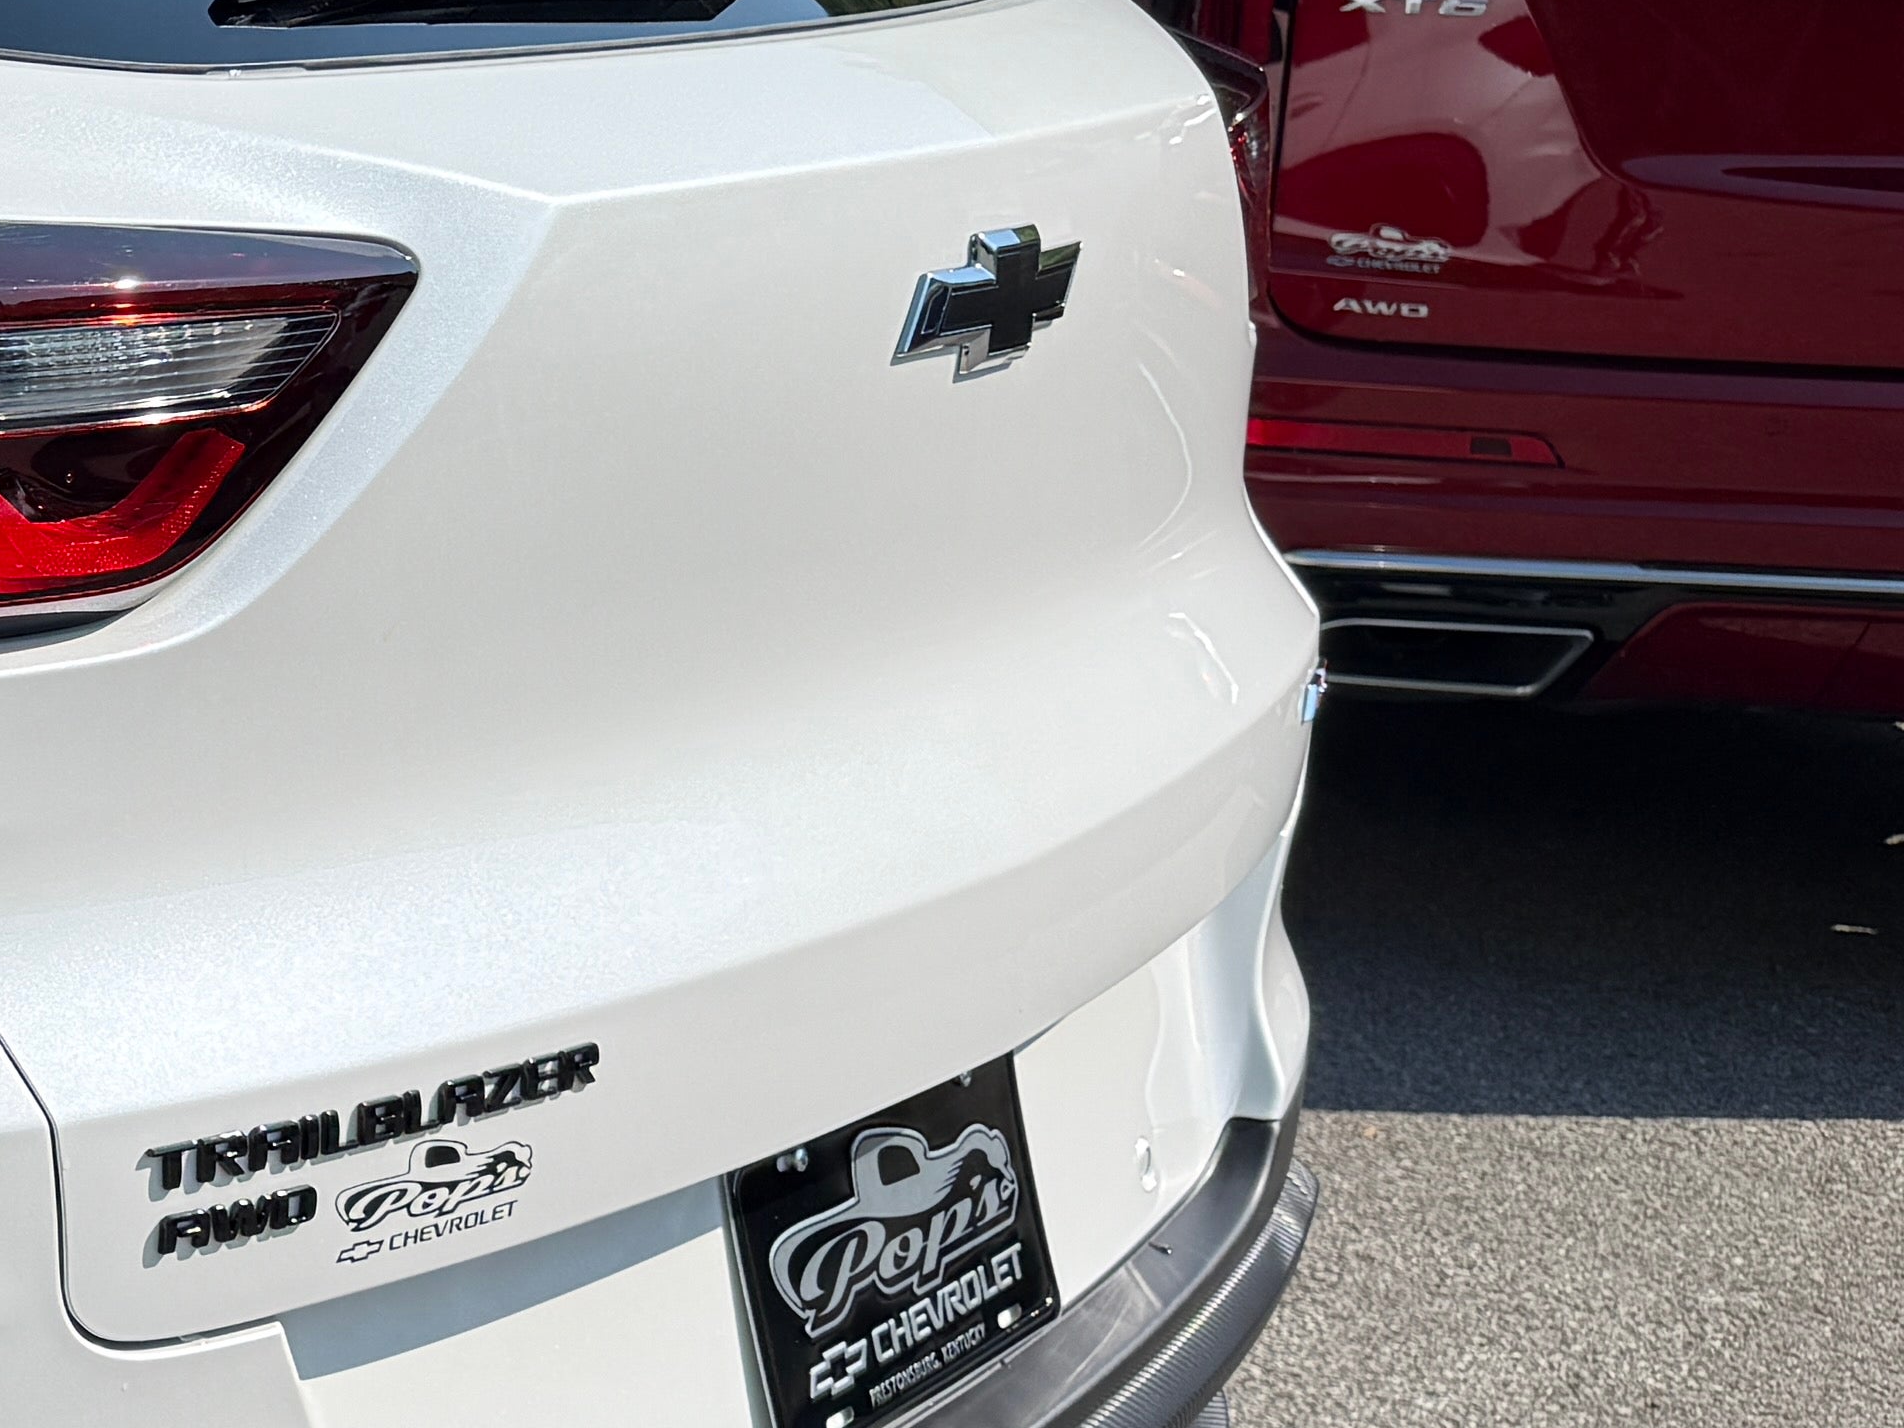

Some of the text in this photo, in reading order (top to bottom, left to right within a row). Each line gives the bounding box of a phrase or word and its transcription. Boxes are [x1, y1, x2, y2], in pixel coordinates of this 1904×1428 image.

[1332, 297, 1430, 319] AWD
[145, 1041, 600, 1190] TRAILBLAZER
[158, 1183, 318, 1255] AWD
[389, 1199, 518, 1251] CHEVROLET
[799, 1178, 1011, 1317] Pop's
[872, 1241, 1022, 1365] CHEVROLET
[940, 1321, 987, 1364] KENTUCKY
